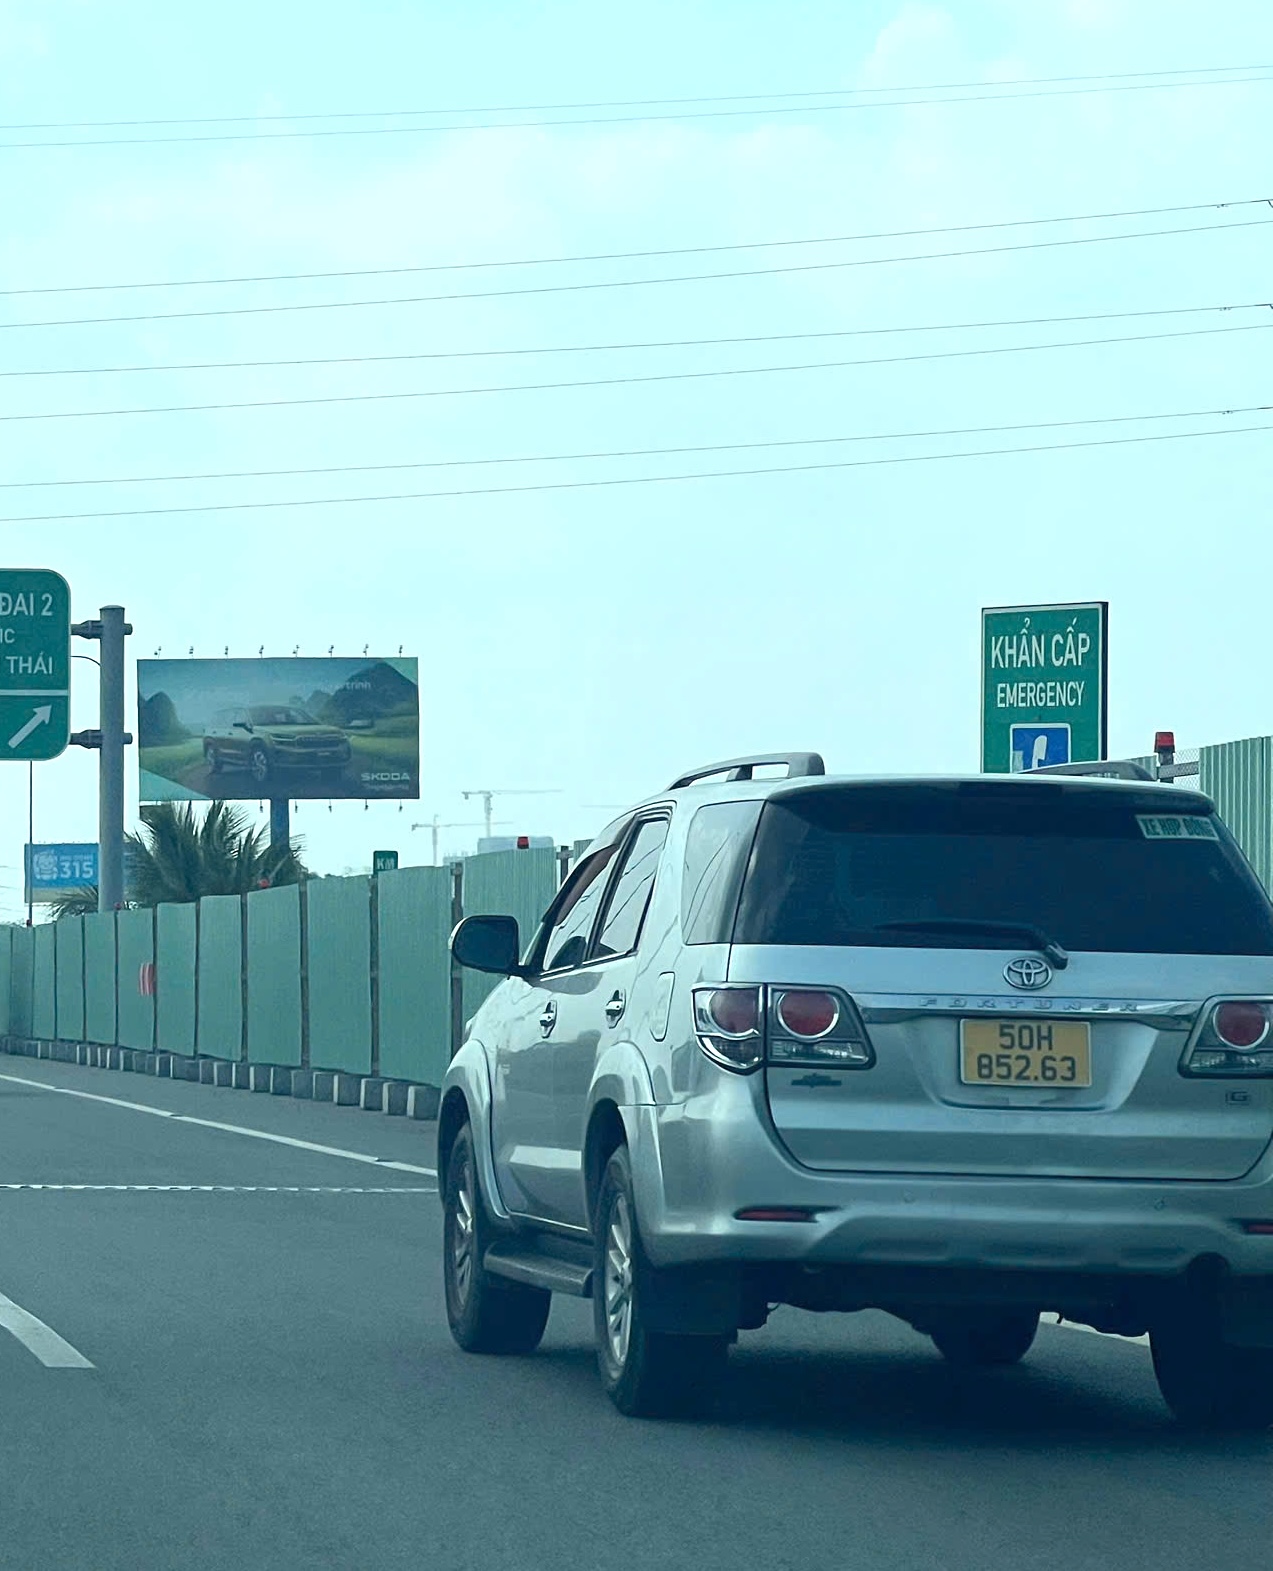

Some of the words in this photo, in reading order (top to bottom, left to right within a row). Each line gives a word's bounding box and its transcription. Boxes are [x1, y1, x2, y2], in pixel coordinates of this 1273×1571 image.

[41, 592, 54, 617] 2
[0, 628, 16, 644] IC
[991, 617, 1045, 668] KHẨN
[1051, 616, 1091, 667] CẤP
[5, 651, 54, 675] THÁI
[996, 681, 1085, 708] EMERGENCY
[360, 772, 410, 781] SKODA
[60, 861, 94, 879] 315
[376, 858, 395, 870] KM
[998, 1023, 1054, 1051] 50H
[976, 1054, 1076, 1082] 852.63
